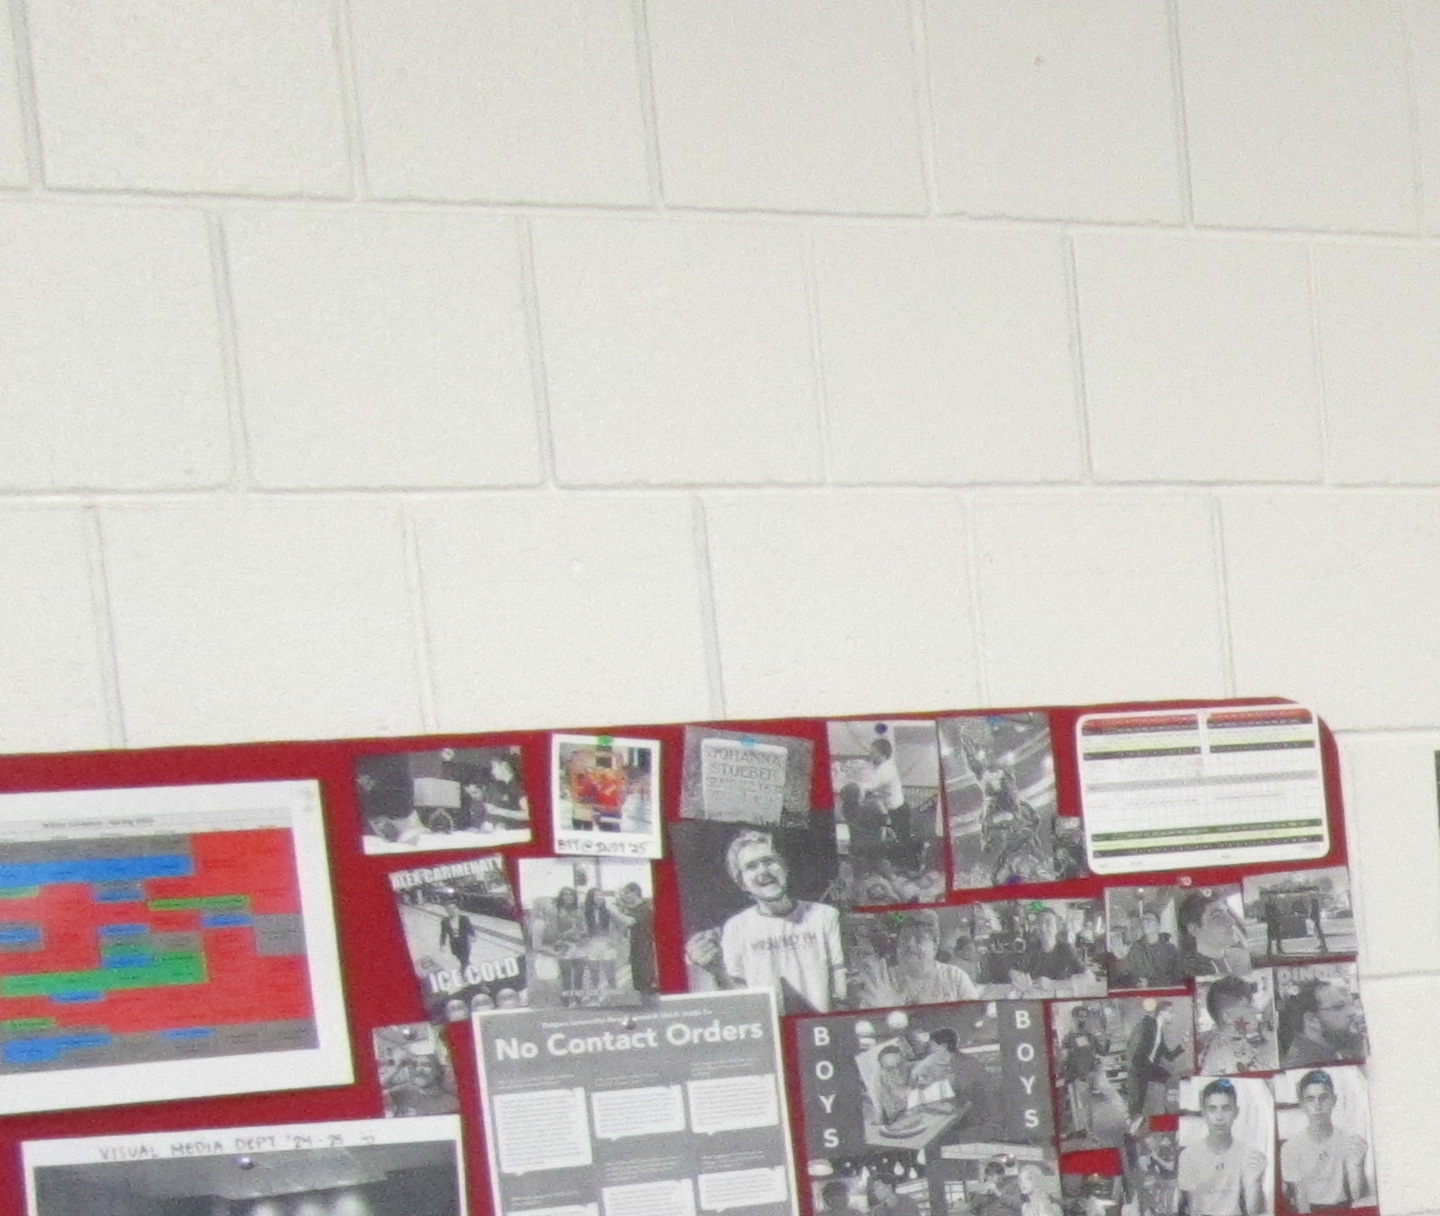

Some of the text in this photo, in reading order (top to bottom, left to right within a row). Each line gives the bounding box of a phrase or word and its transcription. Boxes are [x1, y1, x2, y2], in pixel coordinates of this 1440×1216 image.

[430, 957, 520, 993] ICE COLD
[495, 1037, 539, 1061] No
[547, 1028, 658, 1057] Contact
[666, 1019, 764, 1046] Orders
[813, 1026, 840, 1149] BOYS
[1015, 1009, 1040, 1130] BOYS
[100, 1146, 159, 1161] VISUAL
[170, 1141, 224, 1156] MEDIA
[235, 1136, 277, 1151] DEPT
